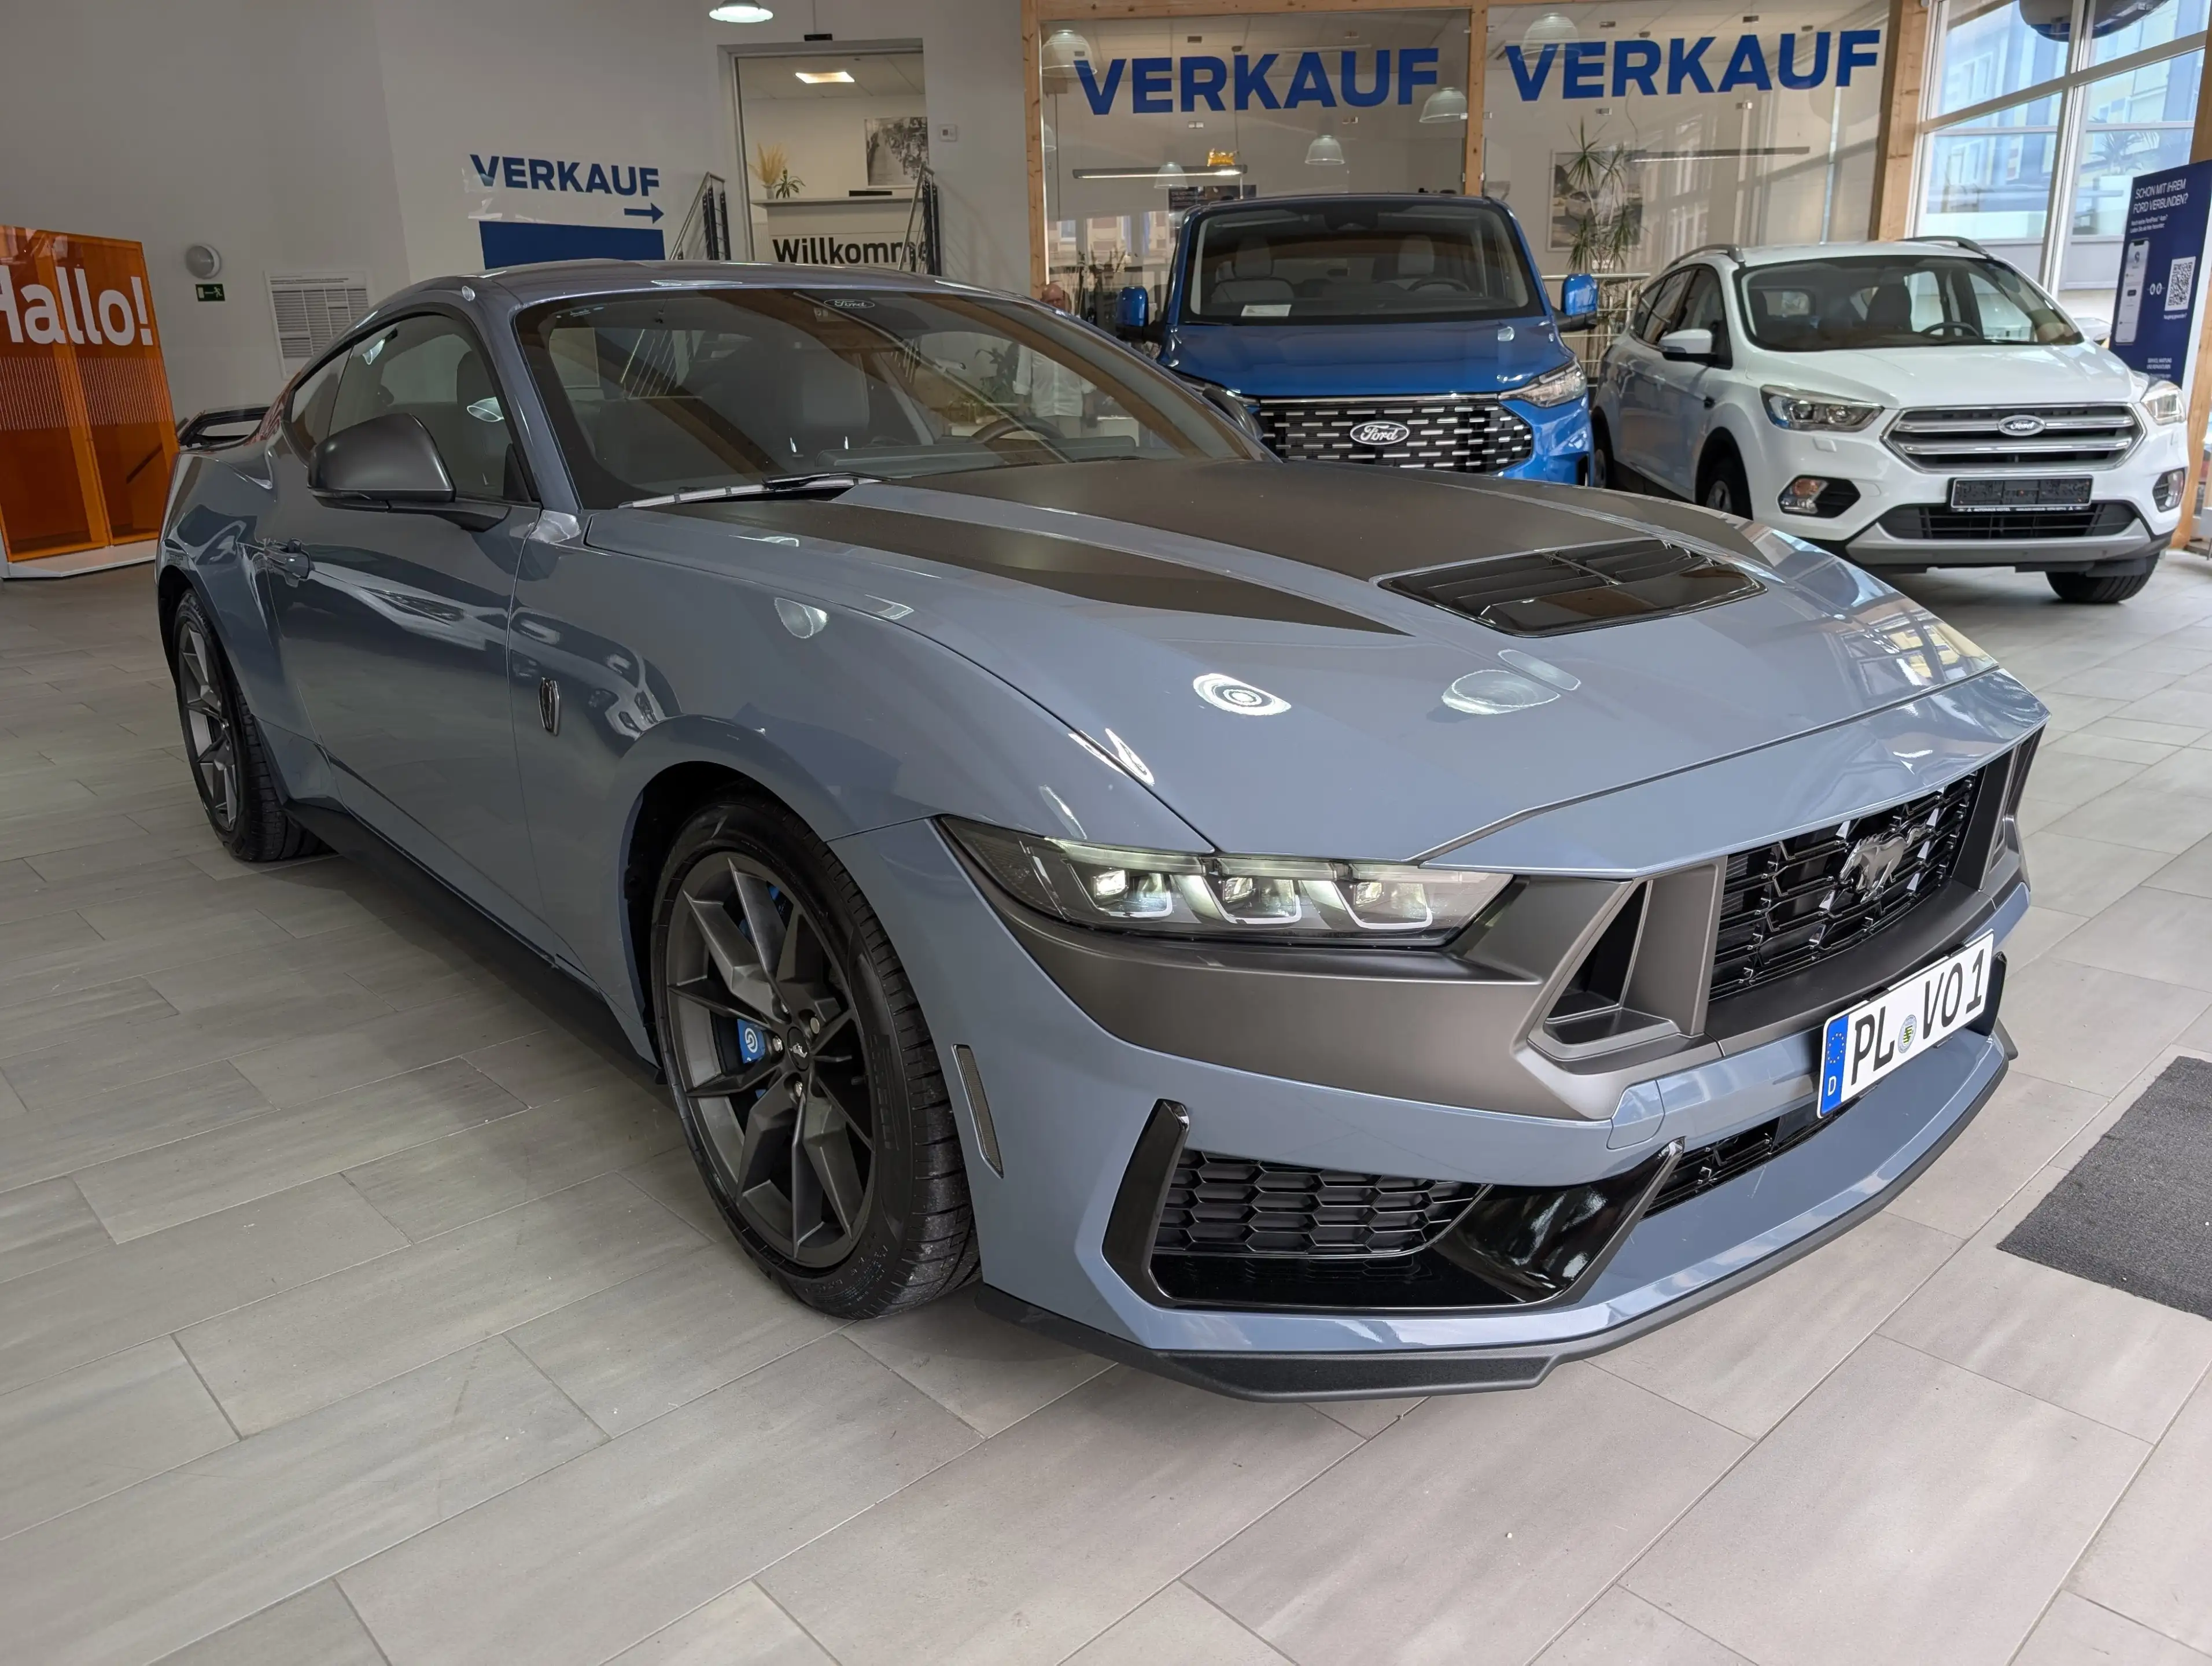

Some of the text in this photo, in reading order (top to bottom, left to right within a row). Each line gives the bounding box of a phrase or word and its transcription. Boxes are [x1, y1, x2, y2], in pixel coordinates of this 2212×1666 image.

[1073, 48, 1439, 116] VERKAUF
[1505, 30, 1881, 102] VERKAUF
[469, 154, 659, 197] VERKAUF
[2135, 178, 2186, 199] SCHON MIT IHREM
[2133, 193, 2188, 214] FORD VERBUNDEN?
[1360, 425, 1398, 441] Ford
[1827, 1075, 1837, 1096] D
[1851, 1006, 1895, 1086] PL
